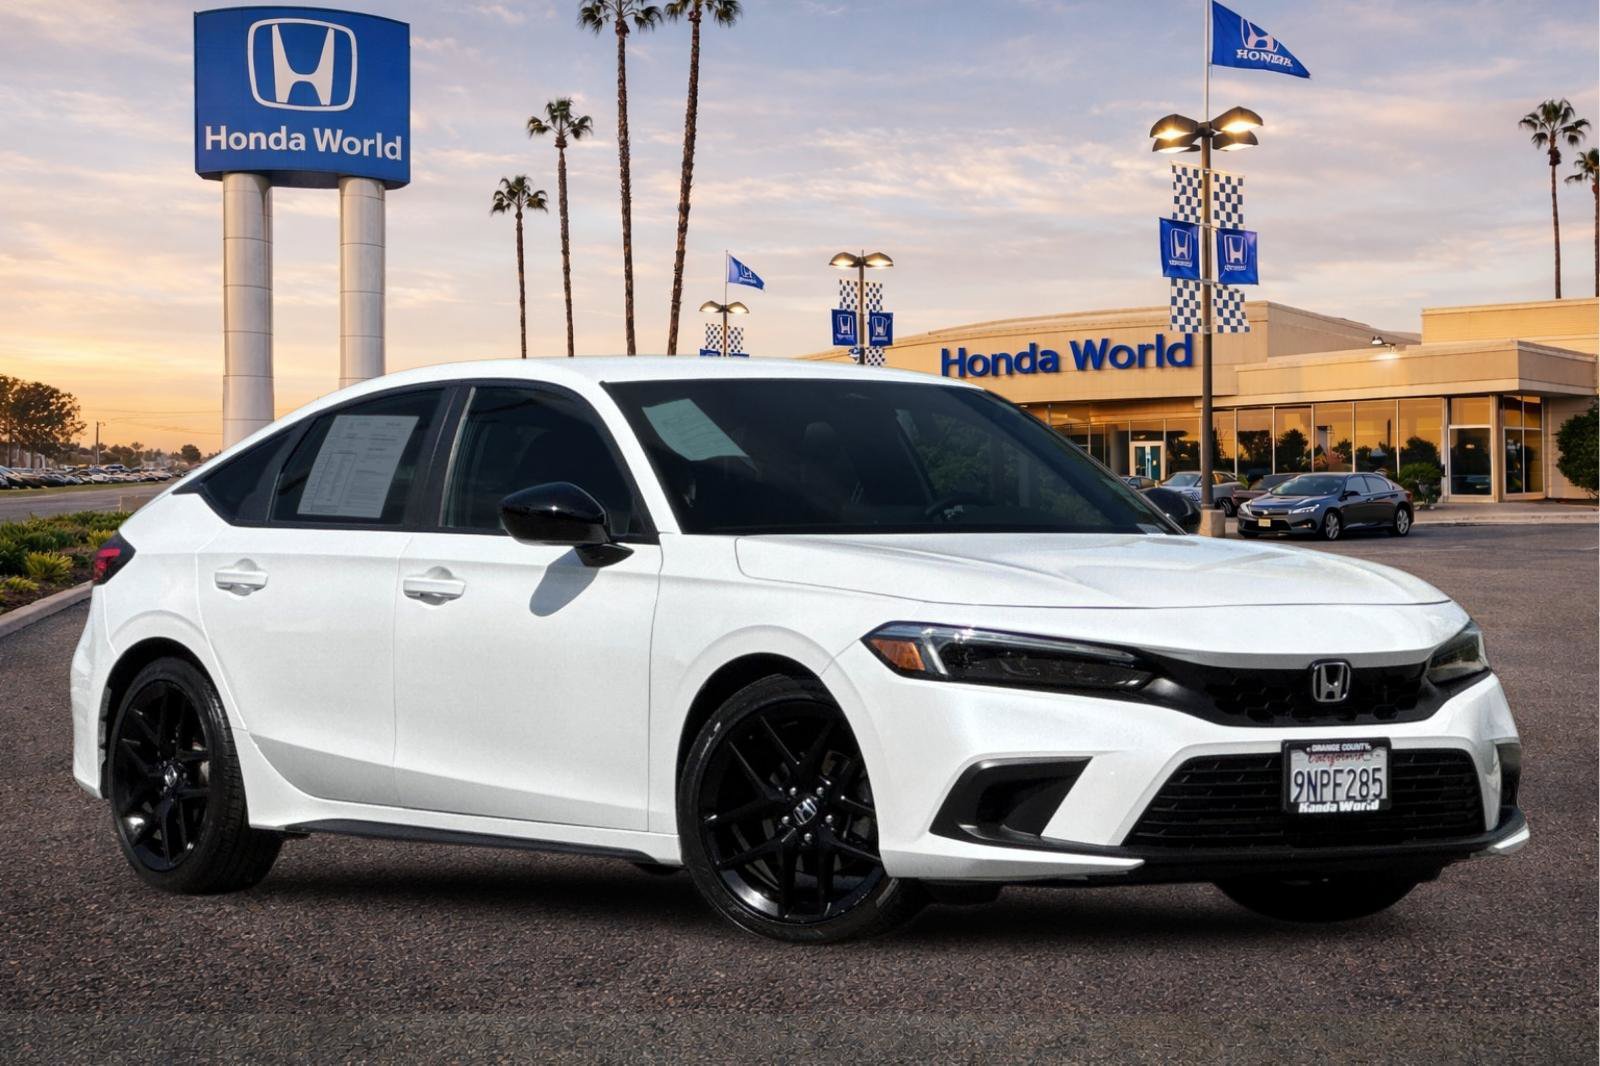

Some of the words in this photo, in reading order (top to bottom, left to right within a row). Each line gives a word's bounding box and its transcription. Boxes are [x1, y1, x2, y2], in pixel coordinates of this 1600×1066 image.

[205, 125, 305, 151] Honda
[313, 128, 402, 161] World
[941, 342, 1060, 377] Honda
[1070, 333, 1194, 371] World
[1311, 743, 1340, 752] ORANGE
[1341, 743, 1368, 751] COUNTY
[1293, 767, 1383, 803] 9NPF285
